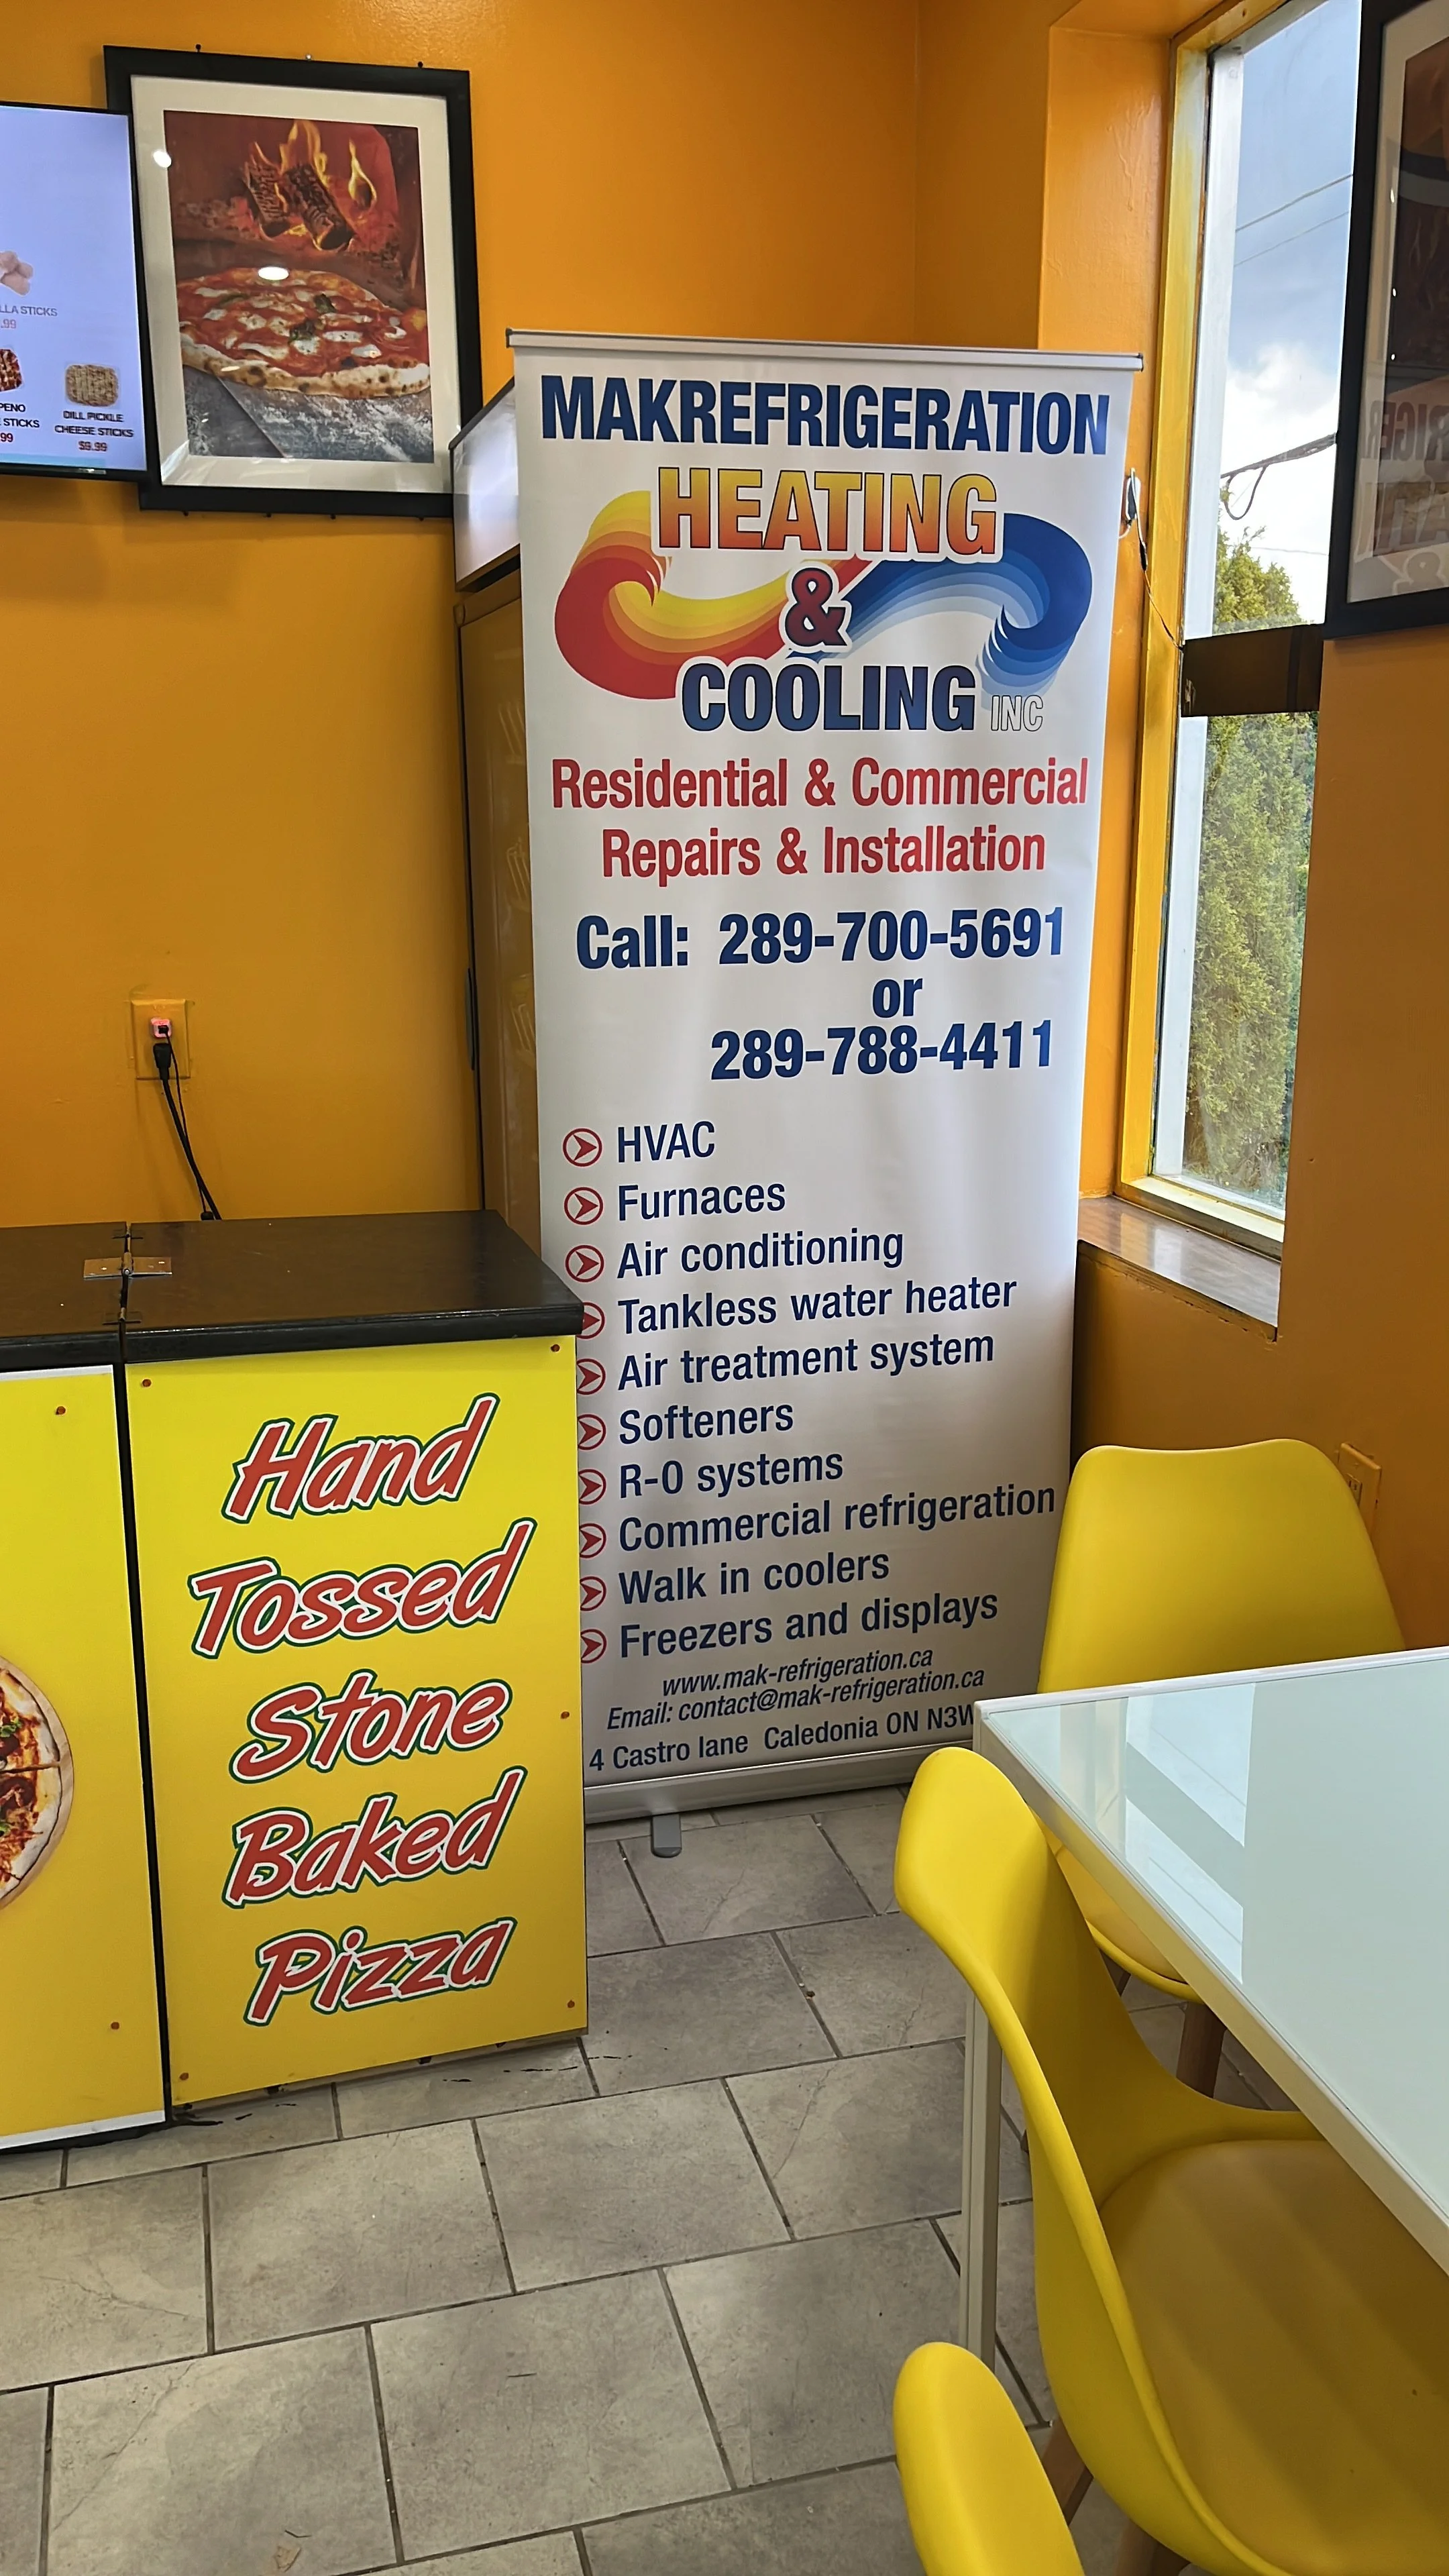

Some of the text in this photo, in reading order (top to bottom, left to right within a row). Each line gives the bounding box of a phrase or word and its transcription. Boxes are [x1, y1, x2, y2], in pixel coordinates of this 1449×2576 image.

[20, 306, 58, 317] STICKS
[3, 418, 40, 428] STICKS
[54, 425, 134, 437] CHEESE STICKS
[63, 411, 124, 423] DILL PICKLE
[541, 374, 1110, 455] MAKREFRIGERATION
[657, 467, 998, 555] HEATING
[785, 568, 849, 647] &
[682, 663, 1043, 732] COOLING INC
[552, 757, 1088, 809] Residential & Commercial
[602, 824, 1045, 888] Repairs & Installation
[576, 906, 1063, 970] Call: 289-700-5691
[872, 977, 923, 1018] or
[710, 1019, 1051, 1081] 289-788-4411
[617, 1120, 715, 1163] HVAC
[619, 1183, 786, 1222] Furnaces
[616, 1227, 903, 1279] Air conditioning
[617, 1277, 1018, 1335] Tankless water heater
[617, 1334, 994, 1391] Air treatment system
[619, 1404, 794, 1445] Softeners
[221, 1393, 501, 1525] Hand
[620, 1453, 843, 1499] R-O systems
[619, 1483, 1055, 1552] Commercial refrigeration
[187, 1517, 539, 1661] Tossed
[618, 1551, 890, 1605] Walk in coolers
[621, 1593, 998, 1658] Freezers and displays
[606, 1669, 985, 1730] Email: contact@mak-refrigeration.ca
[662, 1648, 934, 1697] www.mak-refrigeration.ca
[228, 1669, 510, 1784] Stone
[588, 1748, 605, 1772] 4
[612, 1742, 691, 1770] Castro
[698, 1735, 749, 1758] lane
[764, 1713, 879, 1750] Caledonia
[886, 1709, 919, 1735] ON
[221, 1765, 527, 1910] Baked
[243, 1917, 518, 2028] Pizza
